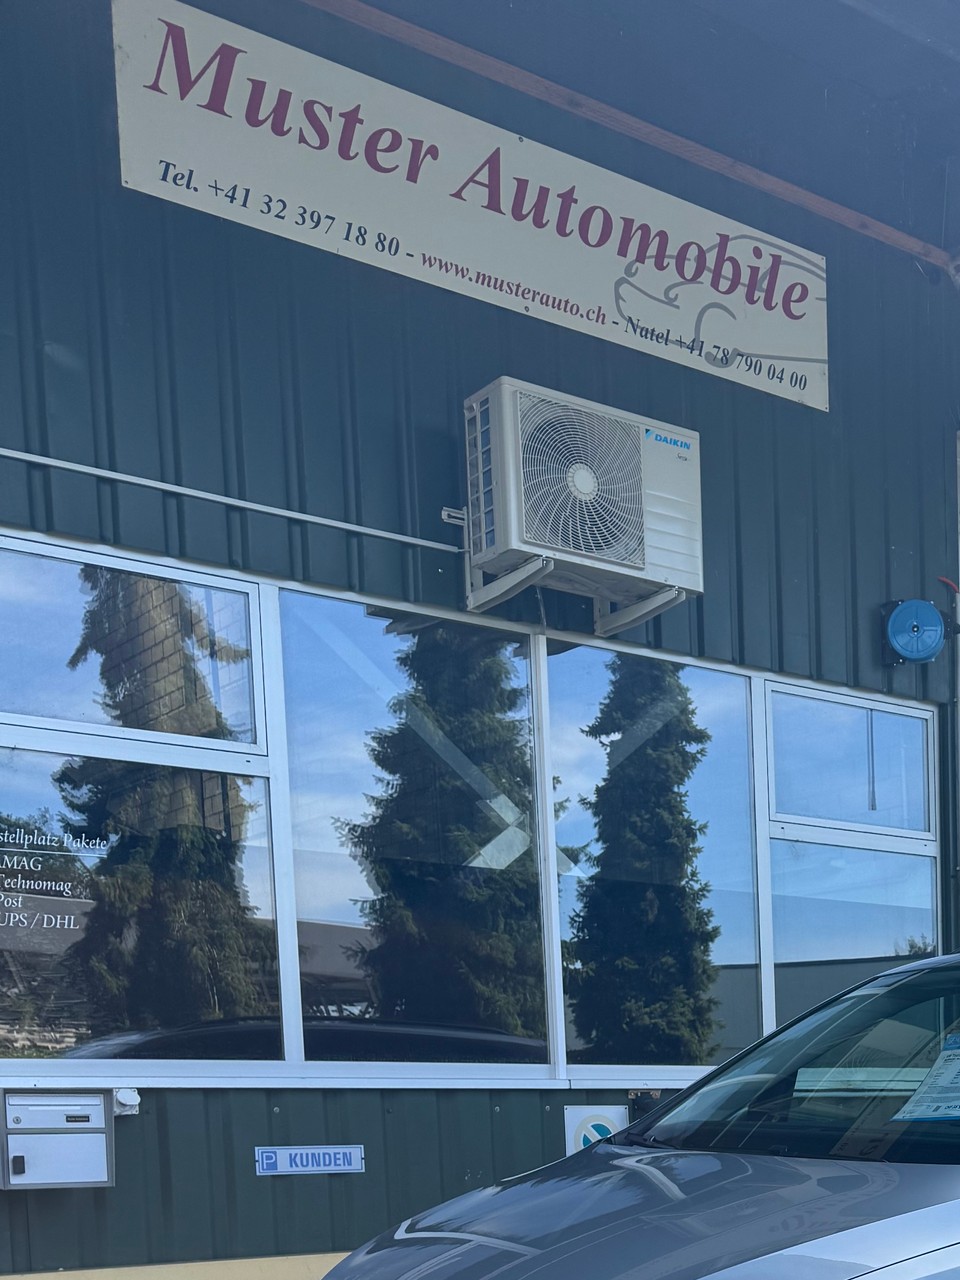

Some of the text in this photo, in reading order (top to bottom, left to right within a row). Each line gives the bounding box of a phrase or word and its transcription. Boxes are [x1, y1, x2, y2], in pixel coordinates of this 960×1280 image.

[143, 18, 809, 320] Muster Automobile
[159, 160, 198, 192] Tel.
[208, 179, 250, 208] +41
[260, 194, 287, 220] 32
[294, 206, 336, 234] 397
[343, 222, 368, 246] 18
[375, 232, 400, 256] 80
[421, 252, 606, 325] www.musterauto.ch
[625, 316, 671, 346] Natel
[675, 335, 704, 357] +41
[712, 344, 730, 366] 78
[735, 353, 762, 376] 790
[767, 364, 785, 384] 04
[790, 371, 807, 391] 00
[654, 433, 691, 450] DAIKIN
[63, 833, 107, 849] Pakete
[0, 855, 42, 871] MAG
[43, 914, 80, 929] DHL
[289, 1151, 353, 1168] KUNDEN
